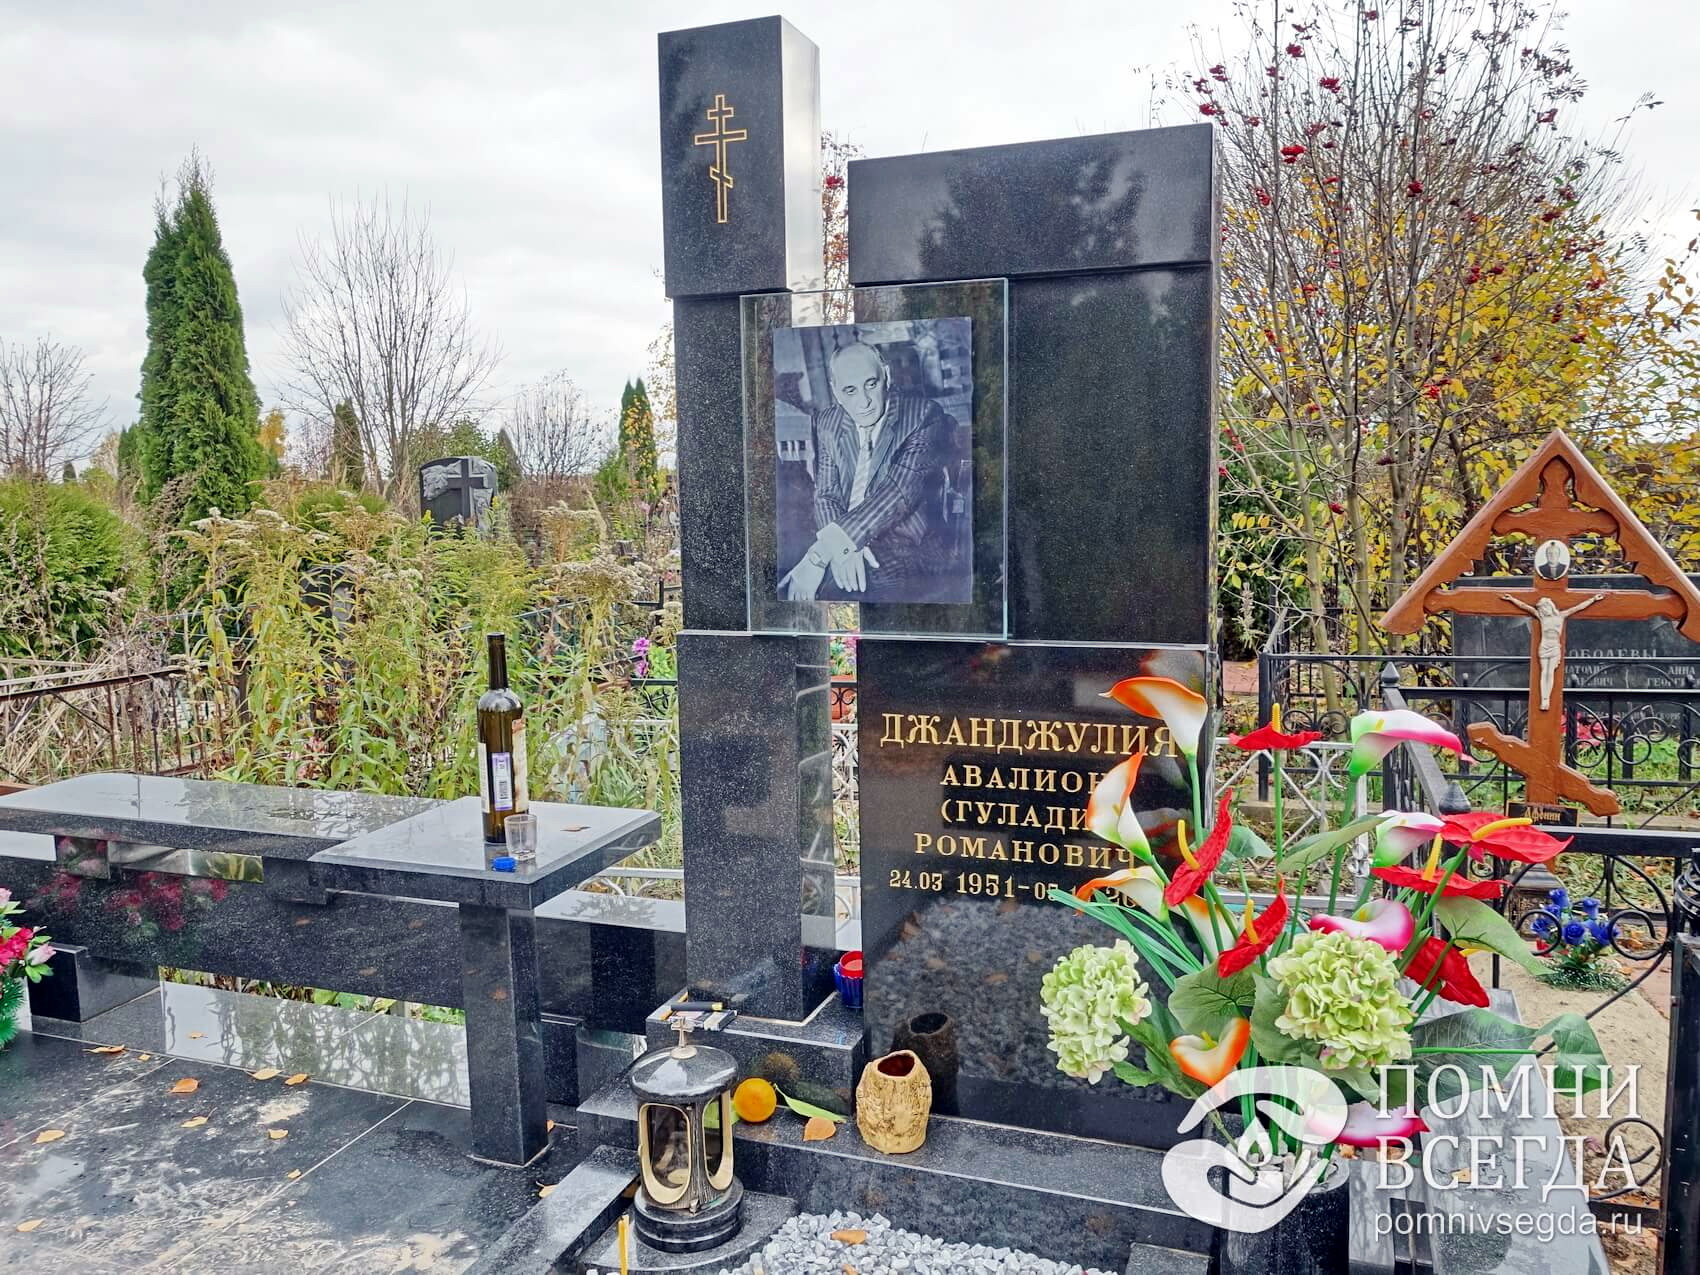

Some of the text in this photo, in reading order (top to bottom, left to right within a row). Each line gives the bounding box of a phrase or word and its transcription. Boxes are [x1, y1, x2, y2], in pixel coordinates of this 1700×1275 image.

[879, 712, 1178, 759] ДЖАНДЖУЛИЯ
[940, 798, 1091, 835] (ГУЛАДИ
[913, 832, 1136, 871] РОМАНОВИЧ
